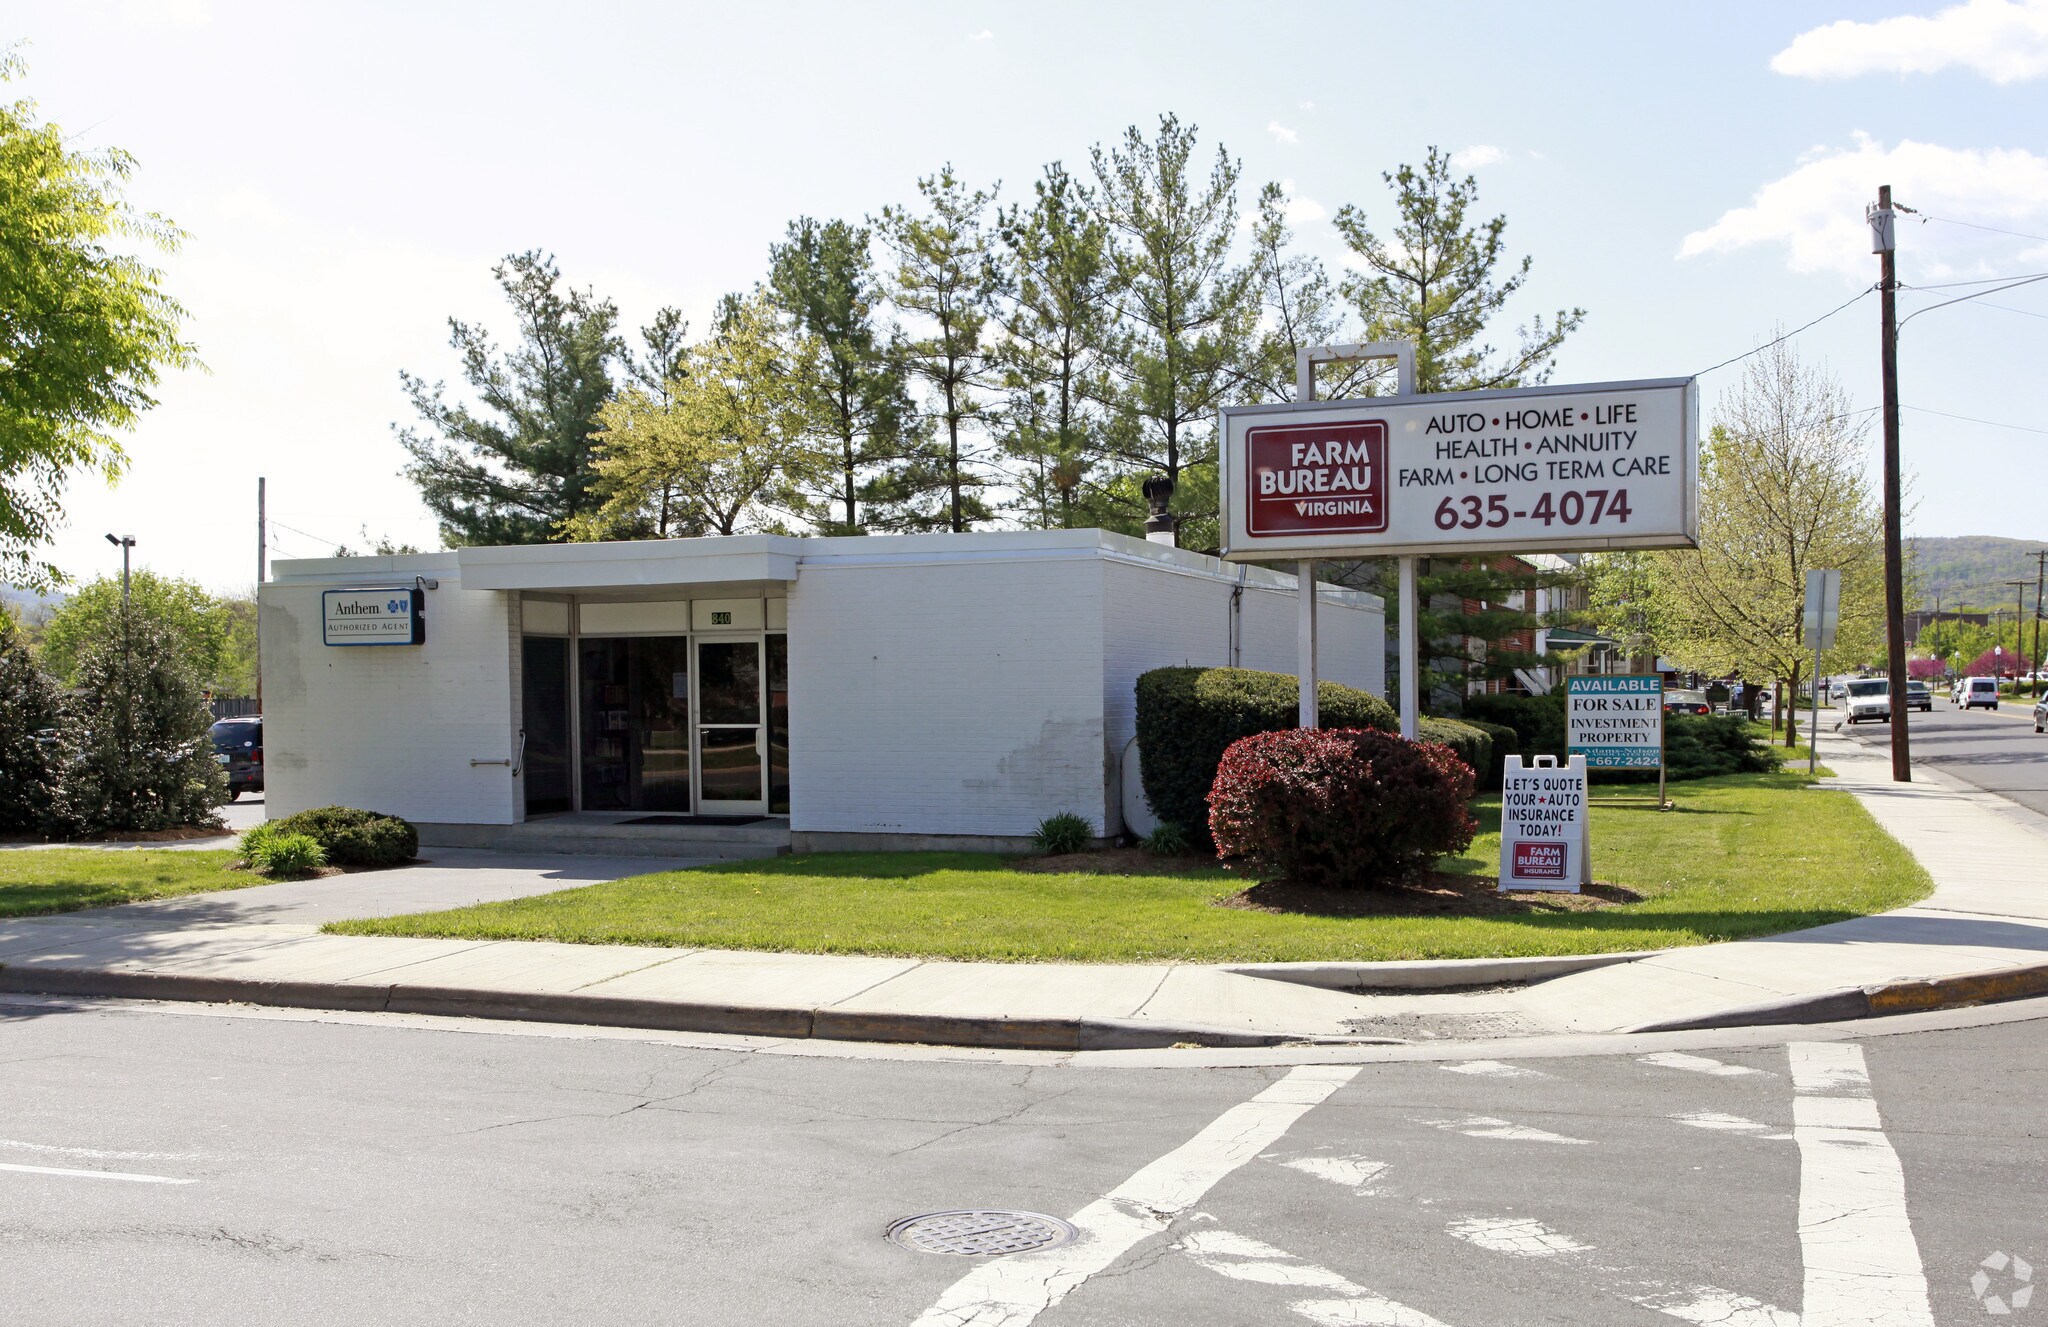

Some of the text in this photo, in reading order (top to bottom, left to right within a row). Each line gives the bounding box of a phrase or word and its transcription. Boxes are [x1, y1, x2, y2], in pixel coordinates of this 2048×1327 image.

[1425, 404, 1638, 435] AUTO HOME LIFE
[1436, 430, 1638, 460] HEALTH ANNUITY
[1291, 439, 1371, 468] FARM
[1399, 456, 1671, 487] FARM LONG TERM CARE
[1260, 466, 1372, 494] BUREAU
[1294, 499, 1374, 518] VIRGINIA
[1434, 488, 1632, 531] 635-4074
[334, 601, 380, 615] Anthem
[712, 613, 731, 624] 840
[328, 623, 378, 632] AUTHORIZED
[1570, 680, 1659, 691] AVAILABLE
[1573, 698, 1657, 711] FOR SALE
[1571, 718, 1659, 729] INVESTMENT
[1579, 733, 1651, 743] PROPERTY
[1596, 757, 1660, 766] 667-2424
[1505, 778, 1583, 791] LET'S QUOTE
[1505, 793, 1580, 806] YOUR AUTO
[1508, 809, 1574, 821] INSURANCE
[1519, 824, 1562, 837] TODAY!
[1530, 847, 1560, 857] FARM
[1518, 856, 1561, 866] BUREAU
